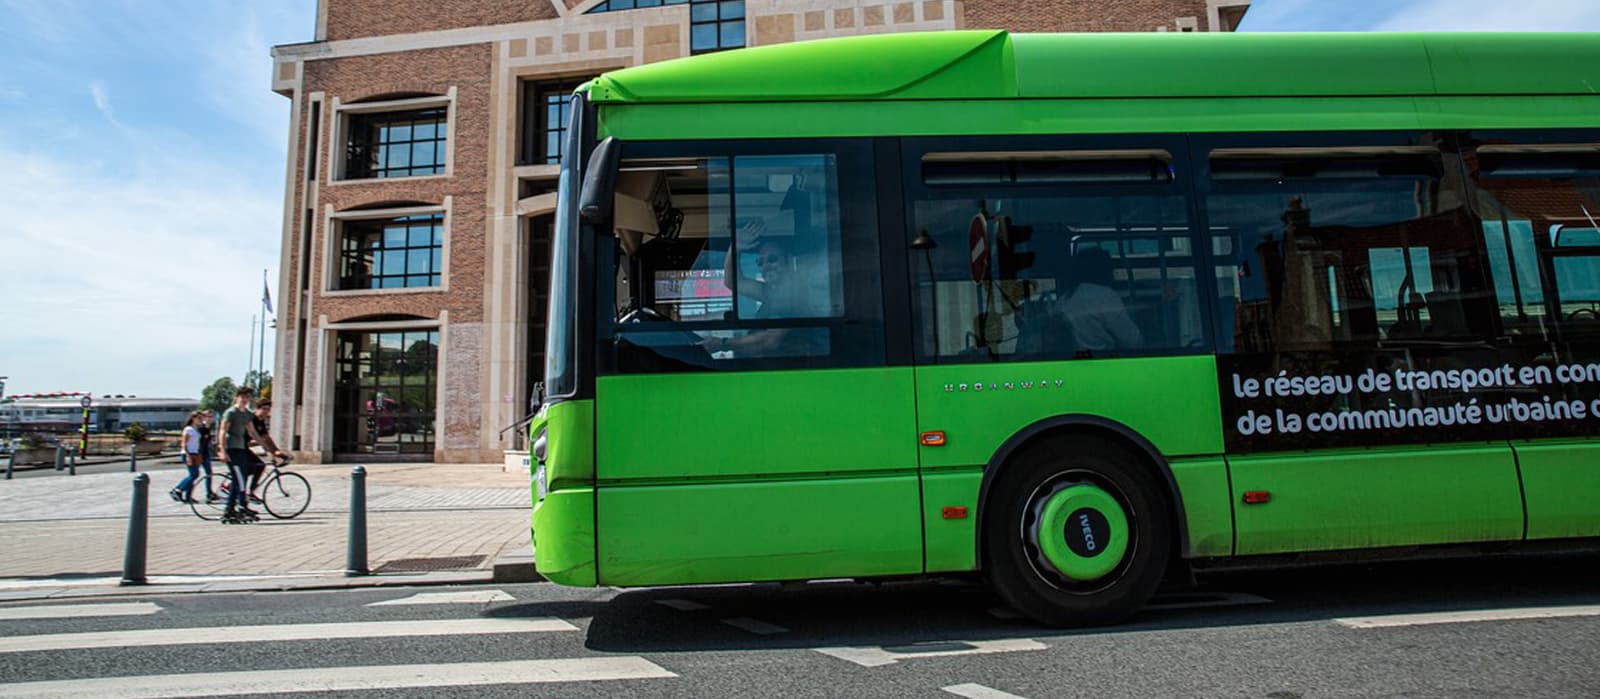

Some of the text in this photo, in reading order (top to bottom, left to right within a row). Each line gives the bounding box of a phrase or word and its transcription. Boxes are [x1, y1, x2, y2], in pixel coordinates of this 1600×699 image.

[1233, 373, 1260, 398] le
[1265, 369, 1354, 397] réseau
[1357, 368, 1391, 393] de
[1395, 363, 1515, 393] transport
[1519, 366, 1553, 385] en
[1237, 410, 1272, 436] de
[1276, 409, 1303, 434] la
[1306, 398, 1482, 432] communauté
[1485, 395, 1587, 424] urbaine
[1079, 514, 1096, 551] IVECO
